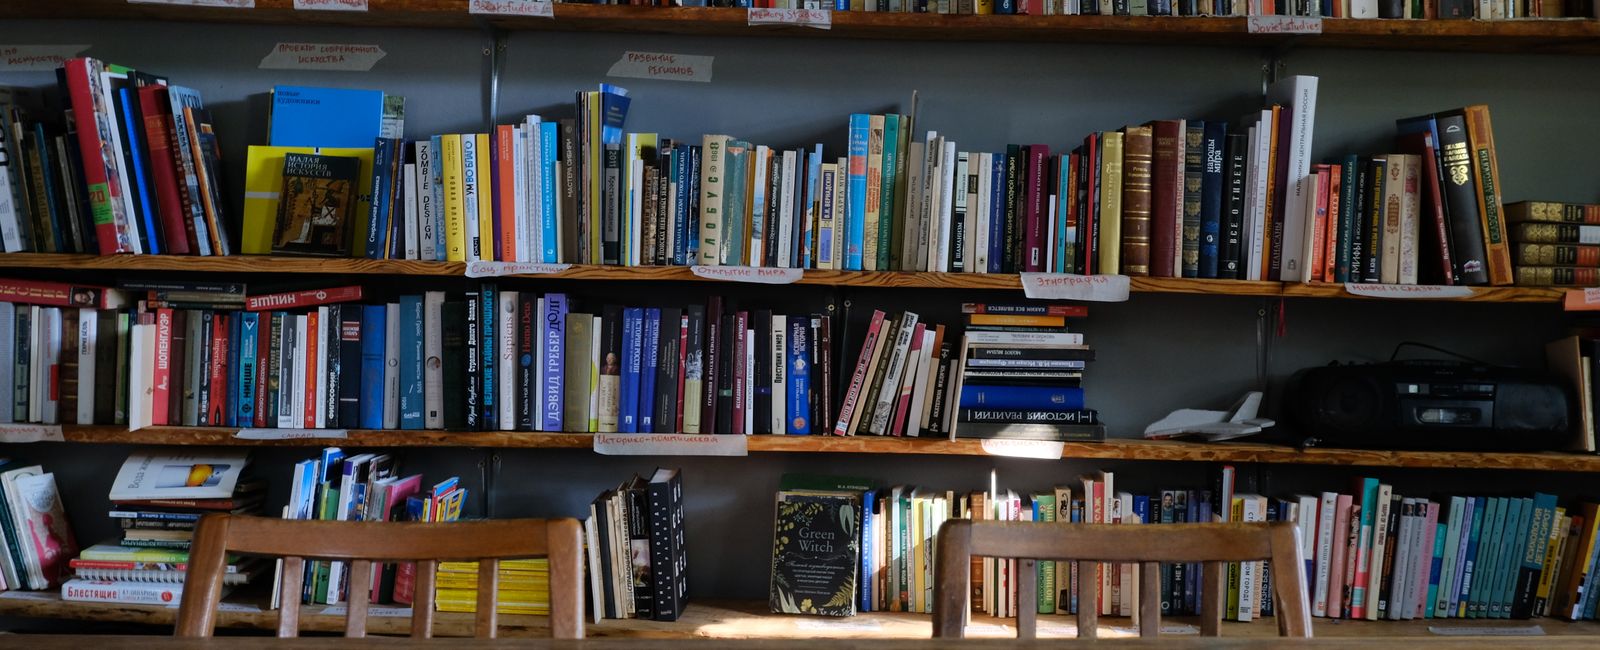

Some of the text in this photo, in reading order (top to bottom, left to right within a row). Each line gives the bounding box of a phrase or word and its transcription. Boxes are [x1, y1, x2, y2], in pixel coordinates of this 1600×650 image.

[286, 161, 328, 173] ИСТОРИЯ
[287, 154, 320, 164] МАЛАЯ
[464, 140, 475, 197] УМ ВО БЛАГО
[565, 138, 574, 198] МАСТЕРА СИБИРИ
[608, 150, 617, 169] 2011
[709, 142, 719, 162] 1968
[1206, 138, 1217, 174] народы
[1212, 149, 1223, 174] мира
[285, 167, 332, 180] ИСКУССТВ
[823, 171, 834, 207] ВЕРНАДСКИЙ
[1231, 154, 1243, 201] ТИБЕТЕ
[368, 175, 383, 243] Спиральная динамика
[421, 145, 432, 240] ZOMBIE DESIGN
[607, 175, 616, 233] Крестьяноведение
[837, 190, 845, 214] КАРТА
[704, 176, 719, 259] ГЛОБУС
[1229, 222, 1238, 245] ВСЕ
[955, 221, 964, 259] ШАМАНИЗМ
[1352, 242, 1362, 273] МИФЫ
[250, 293, 296, 307] НИЦШЕ
[415, 302, 423, 320] Борис
[467, 299, 475, 321] Запада
[158, 313, 169, 370] ШОПЕНГАУЭР
[467, 323, 476, 346] Дикого
[503, 316, 516, 361] Sapiens
[522, 301, 531, 353] Homo Deus
[651, 319, 659, 345] ИСТОРИЯ
[792, 321, 800, 355] ВСЕМИРНАЯ
[799, 326, 807, 352] ИСТОРИЯ
[211, 337, 221, 379] Imperialism
[482, 290, 493, 406] ВЕЛИКИЕ ТАЙНЫ ПРОШЛОГО
[546, 297, 562, 421] ДЭВИД ГРЕБЕР ДОЛГ
[632, 318, 643, 373] ИСТОРИЯ РОССИИ
[773, 333, 784, 383] Преступник номер
[243, 362, 253, 399] НИЦШЕ
[328, 371, 338, 419] ФИЛОСОФИЯ
[933, 388, 943, 418] ЕКАТЕРИНА
[1026, 412, 1074, 423] ИСТОРИЯ
[798, 527, 835, 541] Green
[798, 540, 834, 554] Witch
[1526, 507, 1542, 563] ПСИХОЛОГИЯ
[66, 586, 118, 600] Блестящие
